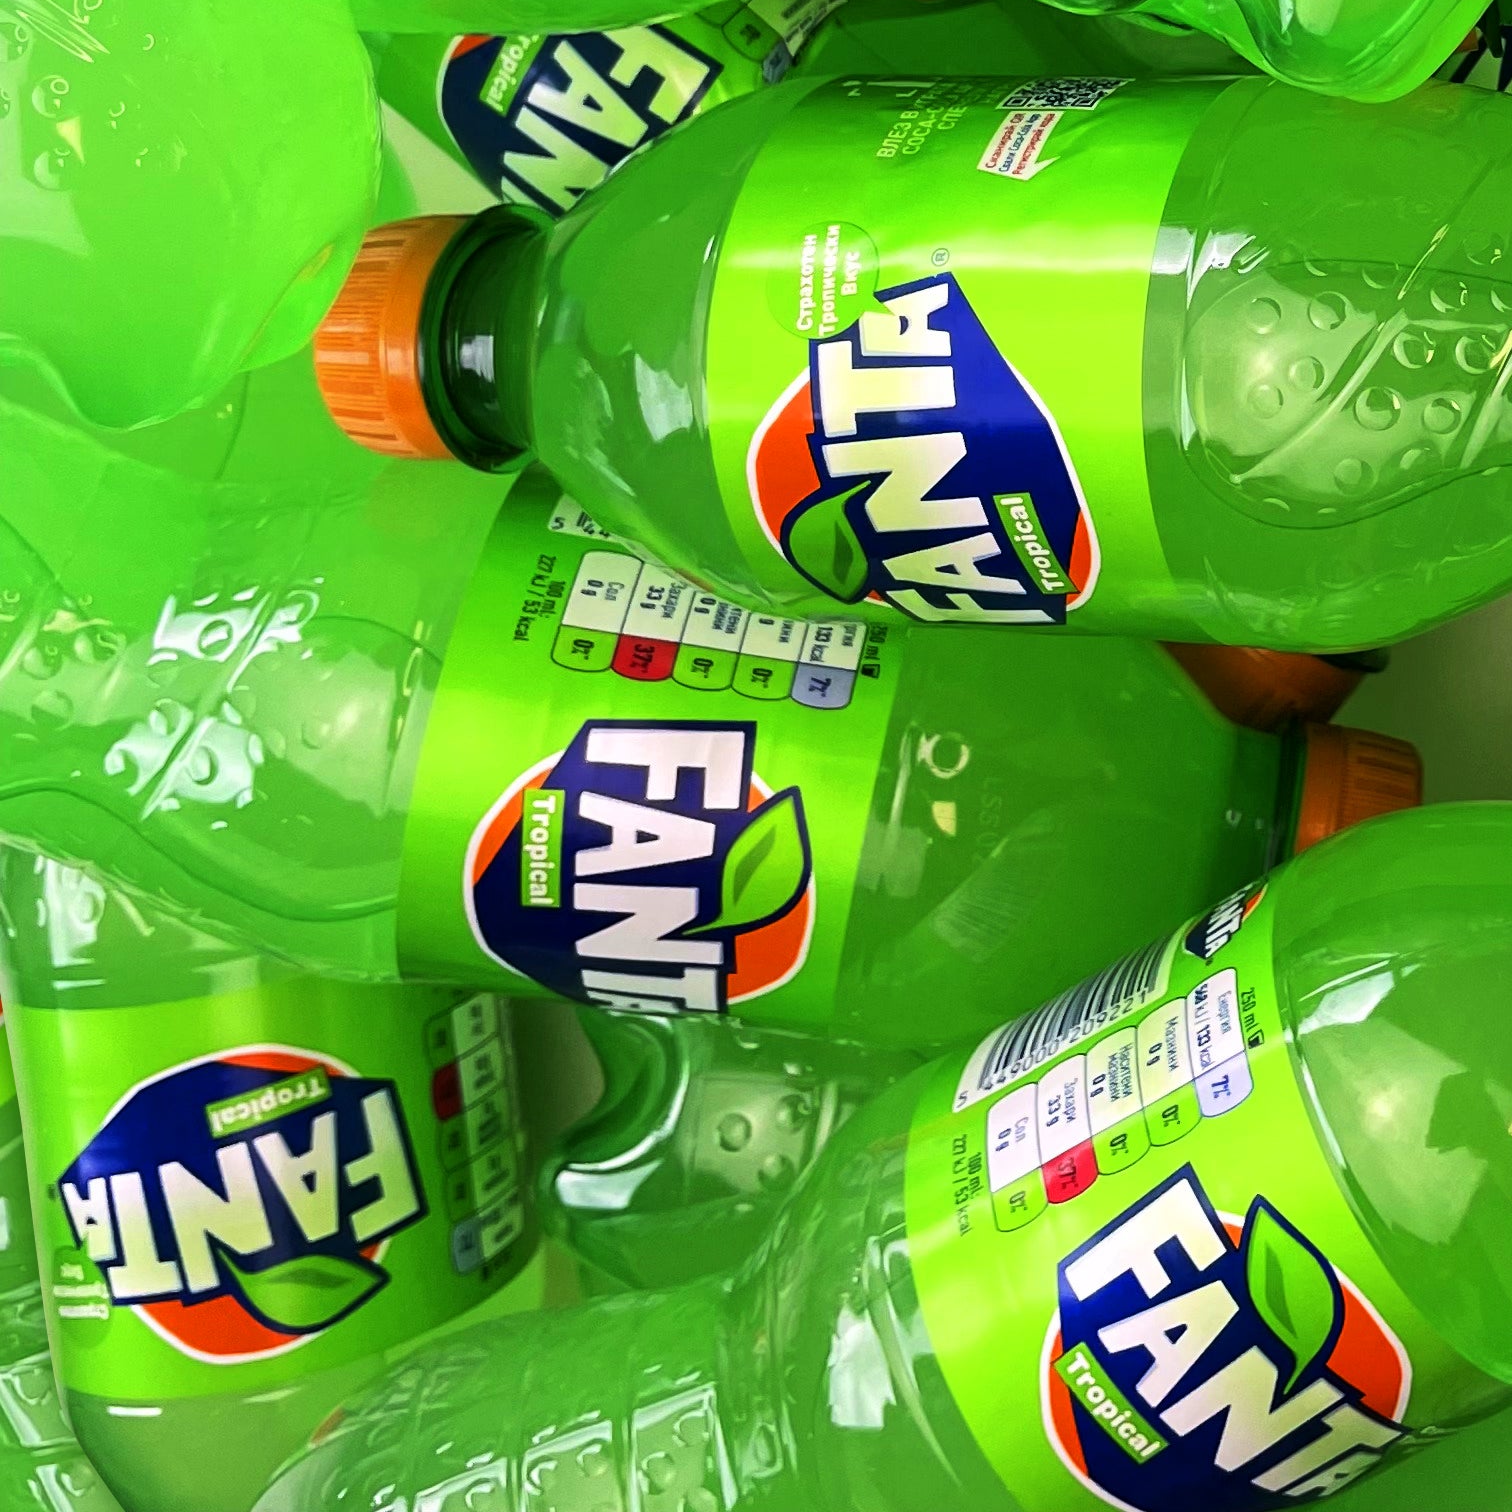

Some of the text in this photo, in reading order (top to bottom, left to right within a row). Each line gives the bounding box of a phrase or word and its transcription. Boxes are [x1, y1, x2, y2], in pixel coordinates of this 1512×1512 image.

[486, 34, 541, 113] ropical
[876, 122, 912, 158] ВЛЕЗ
[984, 125, 1015, 169] Сканирай
[796, 234, 818, 331] Страхотен
[818, 224, 841, 337] Тропически
[840, 251, 861, 297] Вкус
[817, 282, 1055, 623] FANTA
[1000, 496, 1065, 592] Tropical
[604, 581, 625, 602] Сол
[523, 795, 557, 906] Tropical
[1068, 988, 1149, 1042] 209221
[1217, 990, 1232, 1035] Енергия
[1240, 987, 1258, 1032] 250 ml
[1148, 1042, 1163, 1055] 0
[1164, 1016, 1180, 1073] Мазнини
[1197, 1045, 1216, 1071] kcal
[1092, 1073, 1106, 1086] 0
[1117, 1042, 1134, 1098] Наситени
[210, 1077, 328, 1135] Tropical
[1048, 1095, 1062, 1115] 33
[1063, 1077, 1079, 1124] Захари
[1014, 1116, 1029, 1143] Сол
[62, 1088, 420, 1300] FANTA
[954, 1187, 969, 1205] 53
[956, 1205, 973, 1237] kcal
[1065, 1178, 1403, 1497] FANTA
[1066, 1351, 1162, 1457] Tropical
